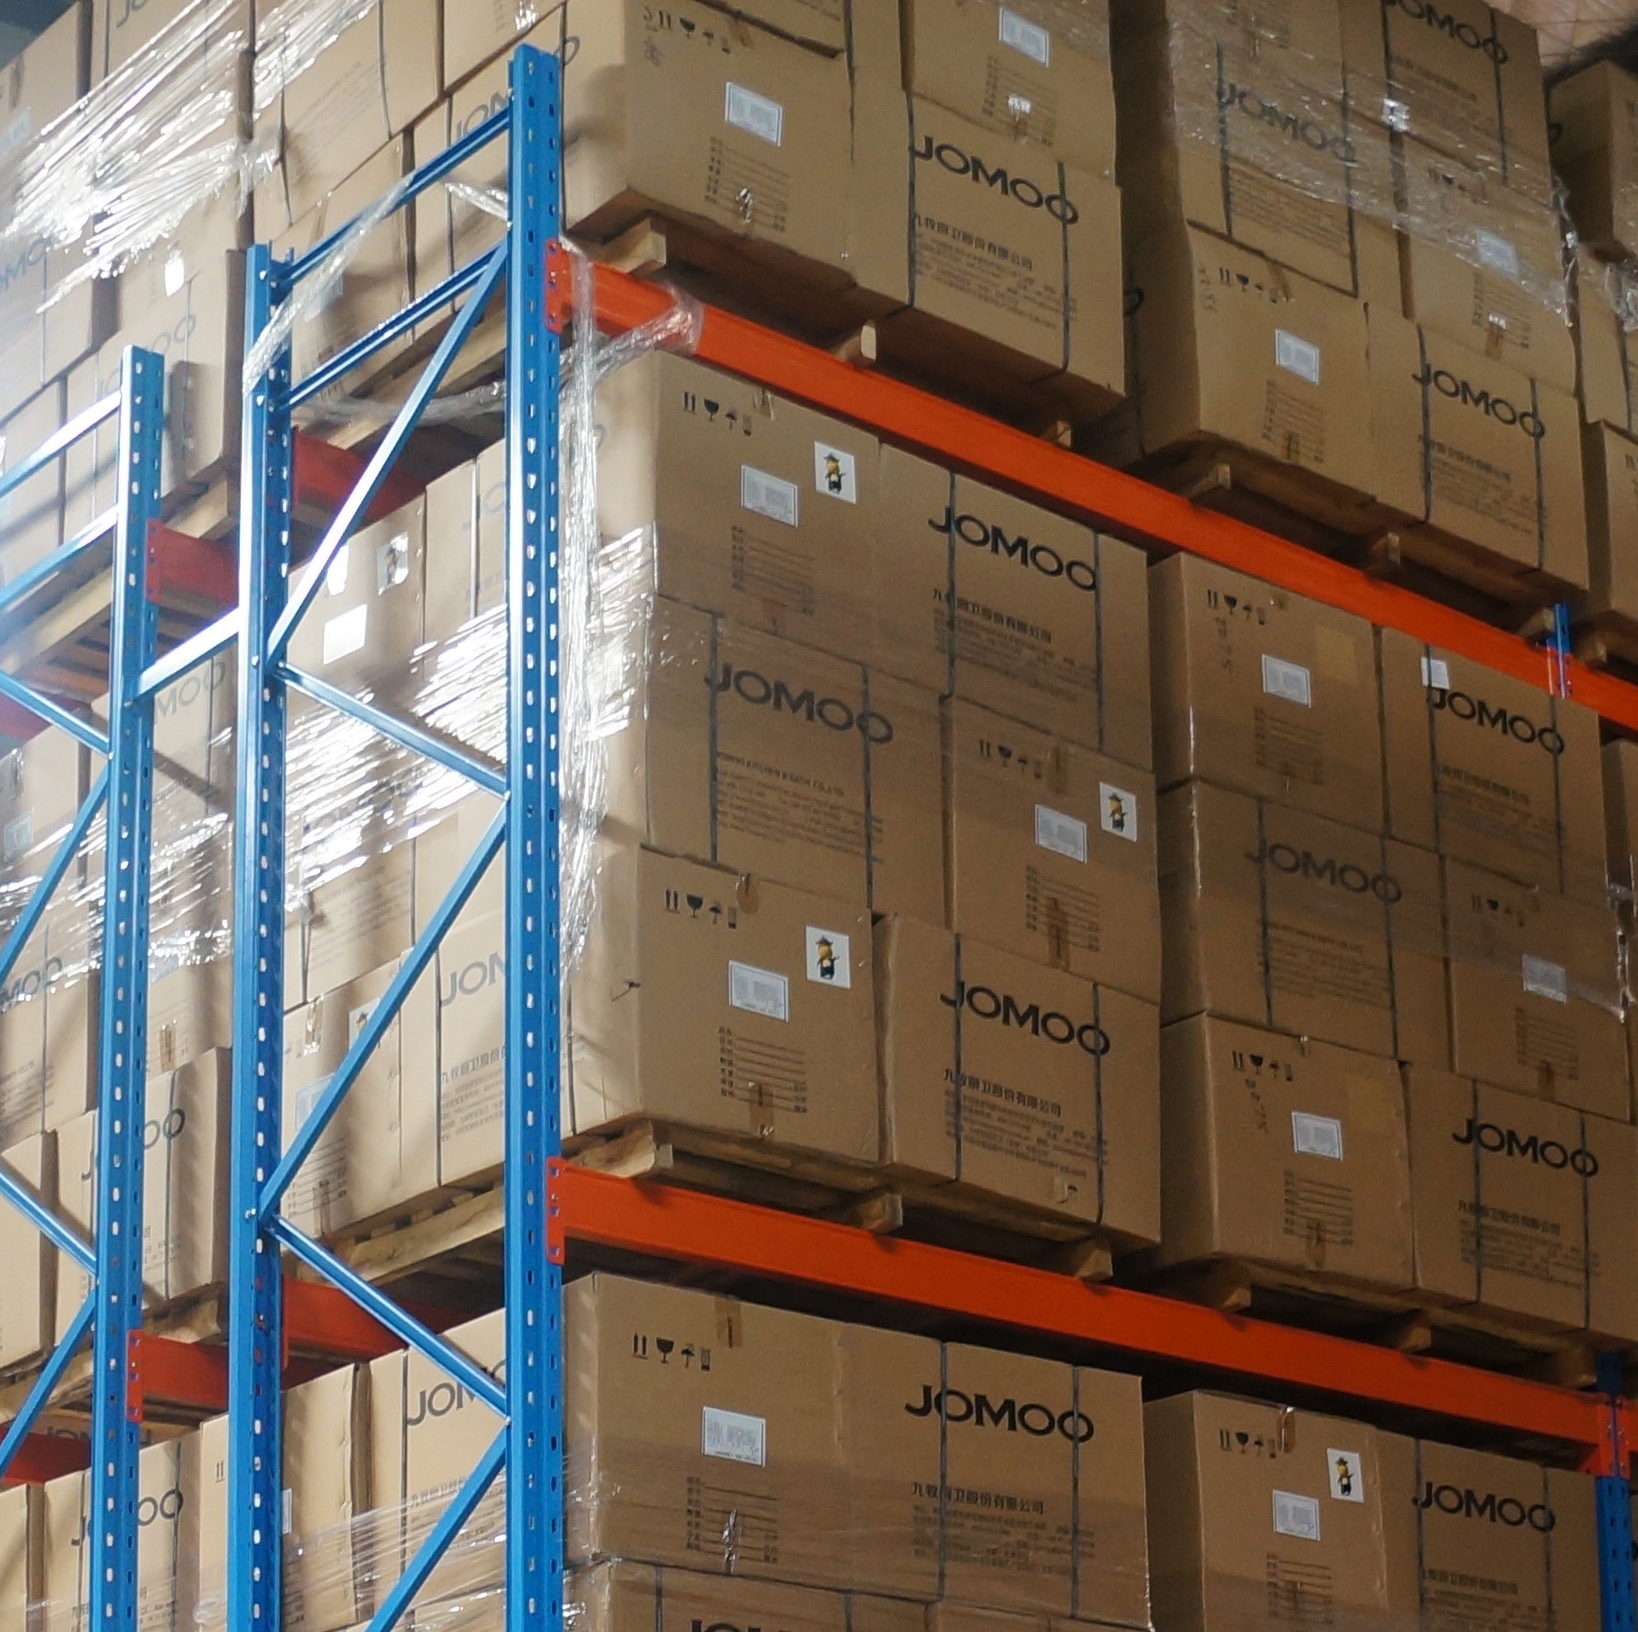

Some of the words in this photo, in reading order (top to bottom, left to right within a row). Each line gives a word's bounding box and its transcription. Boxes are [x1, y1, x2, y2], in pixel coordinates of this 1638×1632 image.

[1221, 85, 1356, 162] JOMOO
[911, 135, 1079, 226] JOMOO
[1412, 363, 1545, 440] JOMOO
[927, 506, 1099, 592] JOMOO
[155, 663, 226, 726] MOO
[704, 662, 893, 745] JOMOO
[1428, 687, 1564, 755] JOMOO
[1246, 837, 1402, 903] JOMOO
[940, 981, 1111, 1056] JOMOO
[1452, 1117, 1599, 1179] JOMOO
[905, 1384, 1094, 1445] JOMOO
[1412, 1482, 1555, 1532] JOMOO
